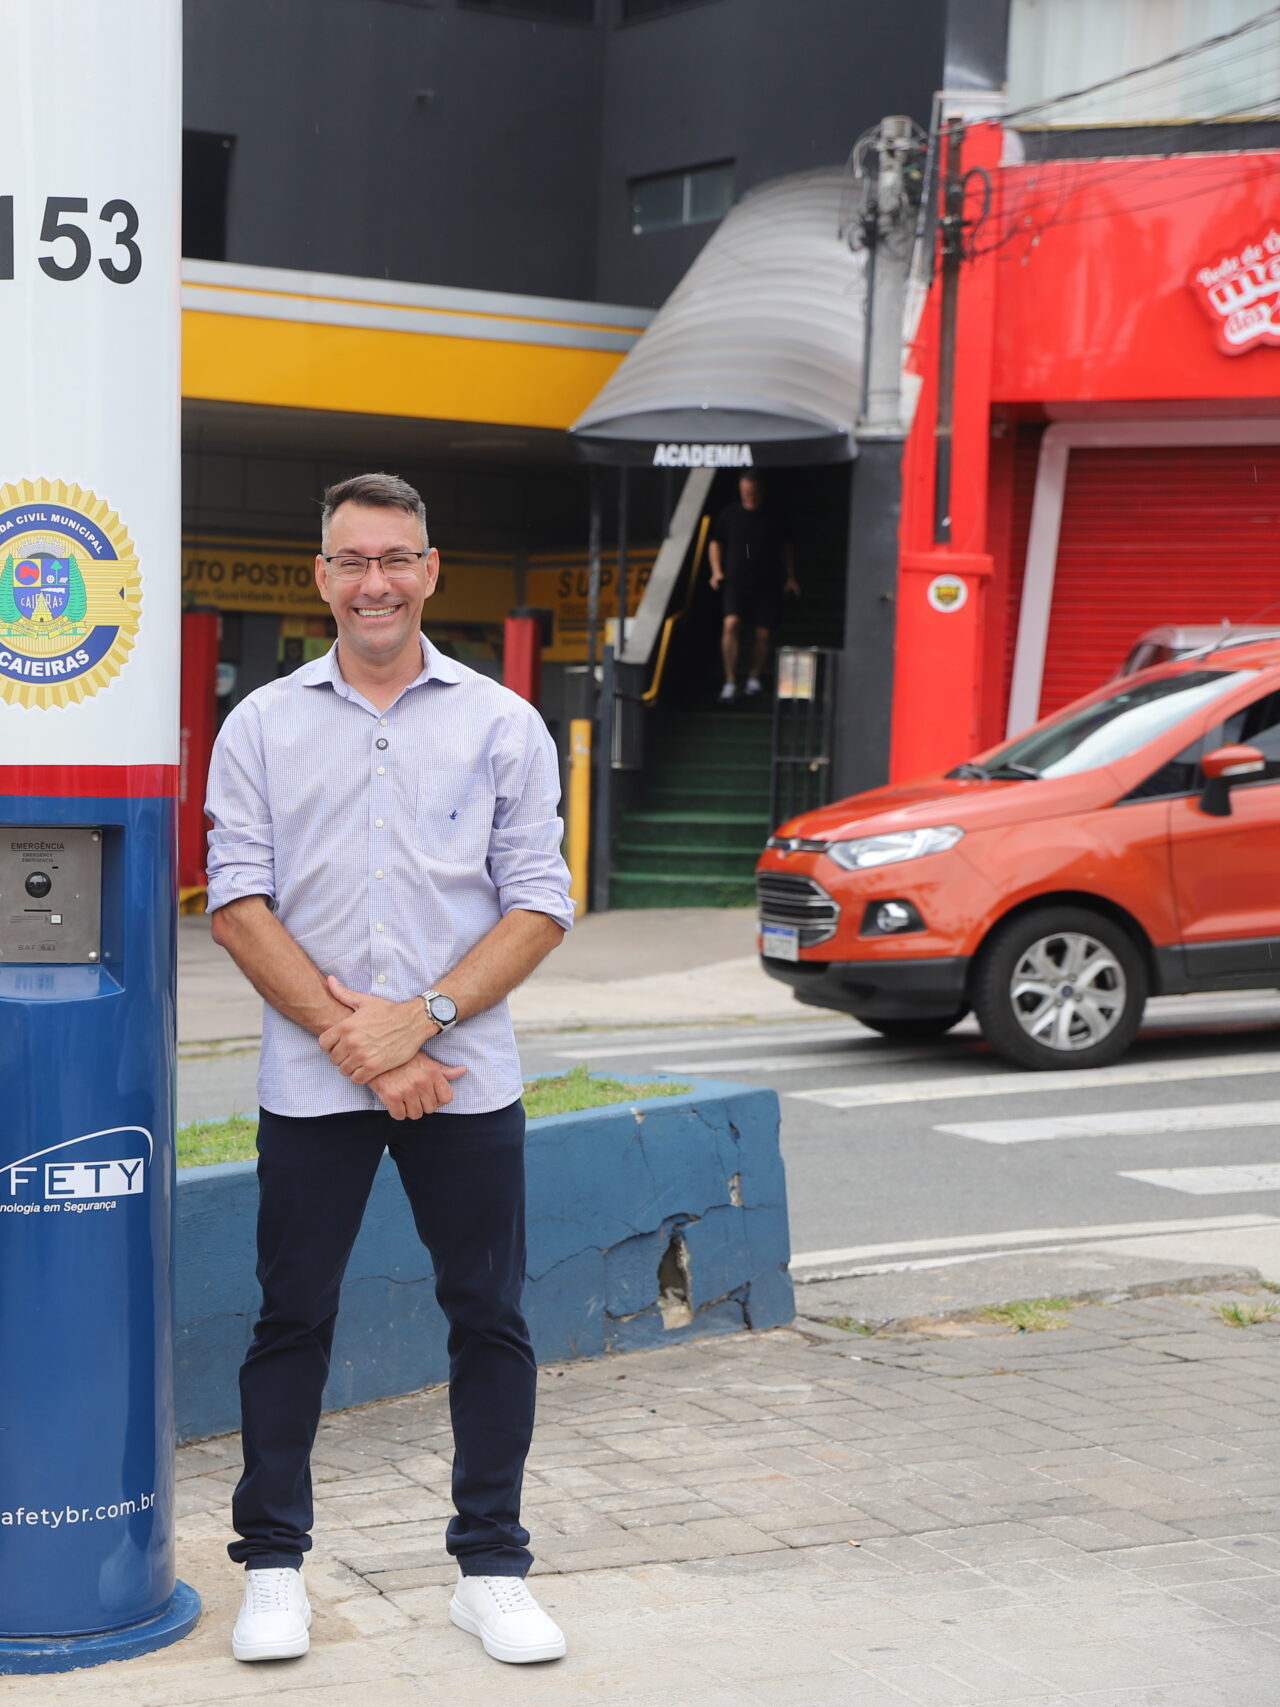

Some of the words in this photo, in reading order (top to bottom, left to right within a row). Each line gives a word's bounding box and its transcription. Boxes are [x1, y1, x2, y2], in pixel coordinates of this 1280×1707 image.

[653, 443, 754, 467] ACADEMIA
[16, 512, 48, 526] CIVIL
[51, 513, 105, 554] MUNICIPAL
[231, 562, 312, 589] POSTO
[10, 841, 65, 850] EMERGÊNCIA
[43, 1204, 61, 1213] em
[63, 1200, 117, 1213] Segurança
